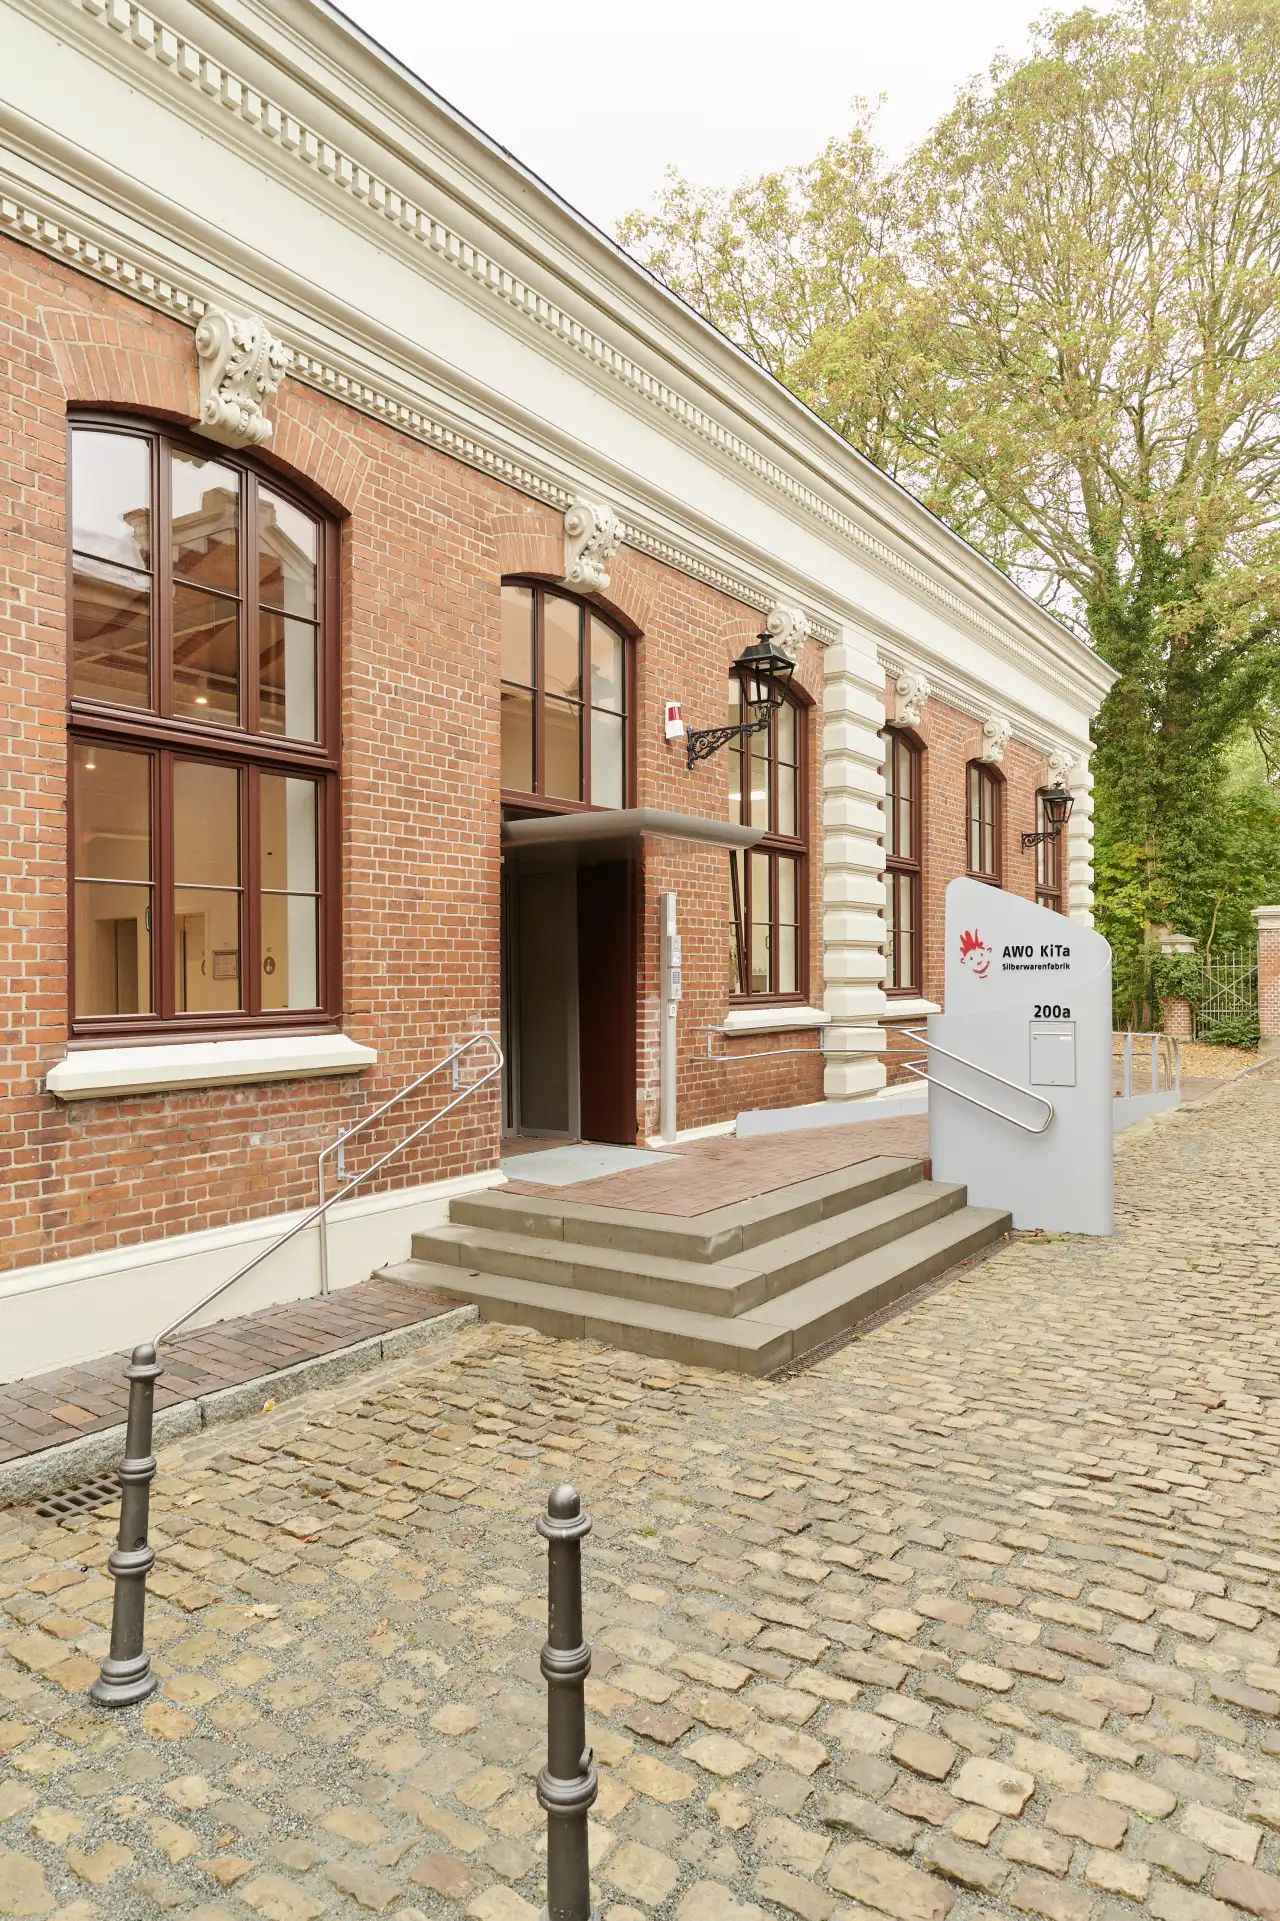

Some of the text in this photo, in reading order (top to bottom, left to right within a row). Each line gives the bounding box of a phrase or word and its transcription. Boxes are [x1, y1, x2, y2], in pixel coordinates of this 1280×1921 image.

[1002, 944, 1071, 958] AWO KiTa
[1002, 962, 1071, 971] Silberwarenfabrik
[1033, 1004, 1071, 1018] 200a
